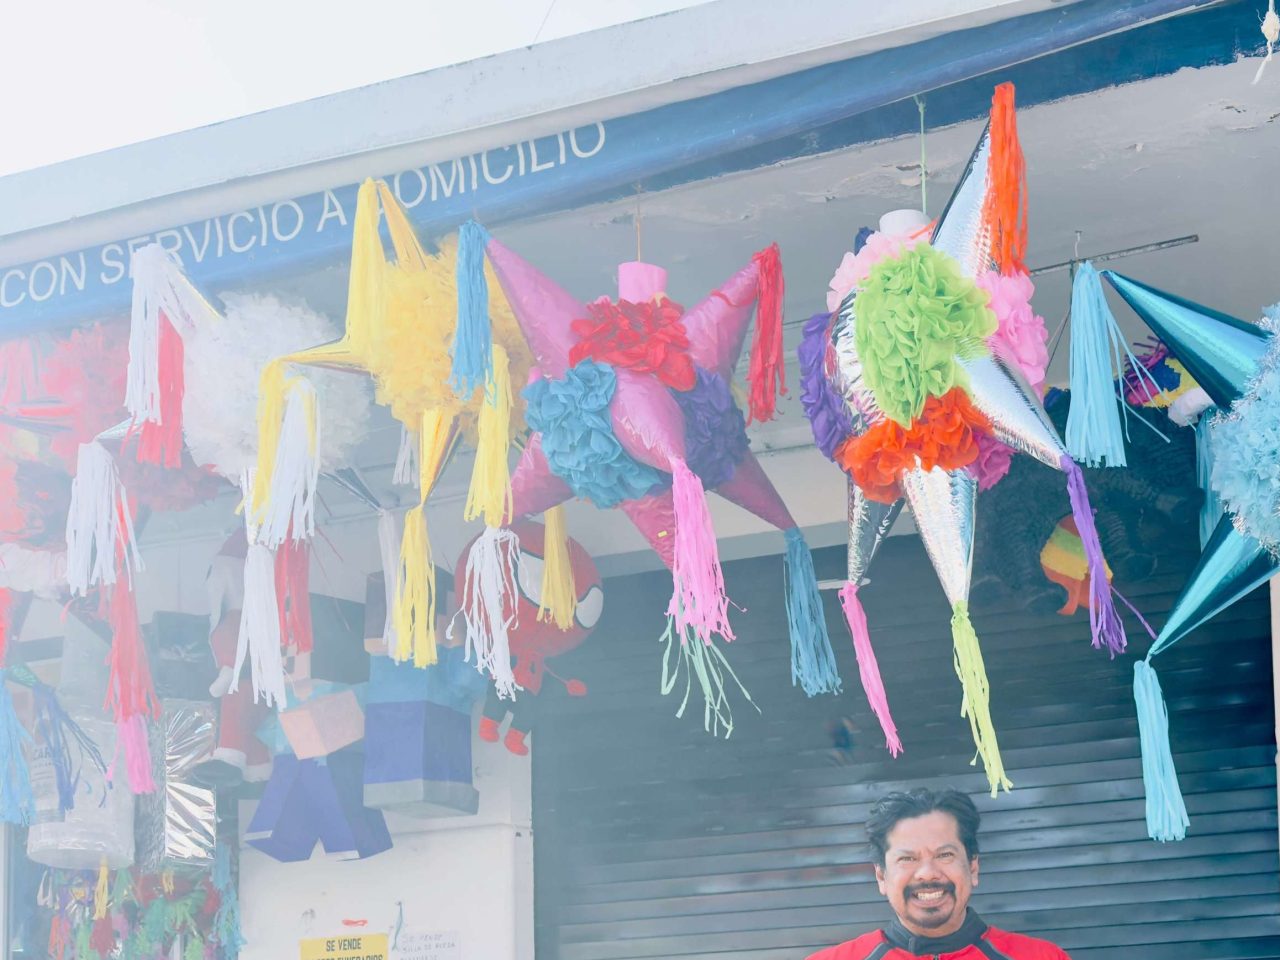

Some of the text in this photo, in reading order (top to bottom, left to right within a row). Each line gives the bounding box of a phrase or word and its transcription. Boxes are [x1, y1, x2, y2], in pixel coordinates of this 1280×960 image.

[0, 252, 87, 308] CON
[315, 188, 348, 233] A
[376, 121, 606, 216] OMICILIO
[326, 938, 362, 952] SE VENDE
